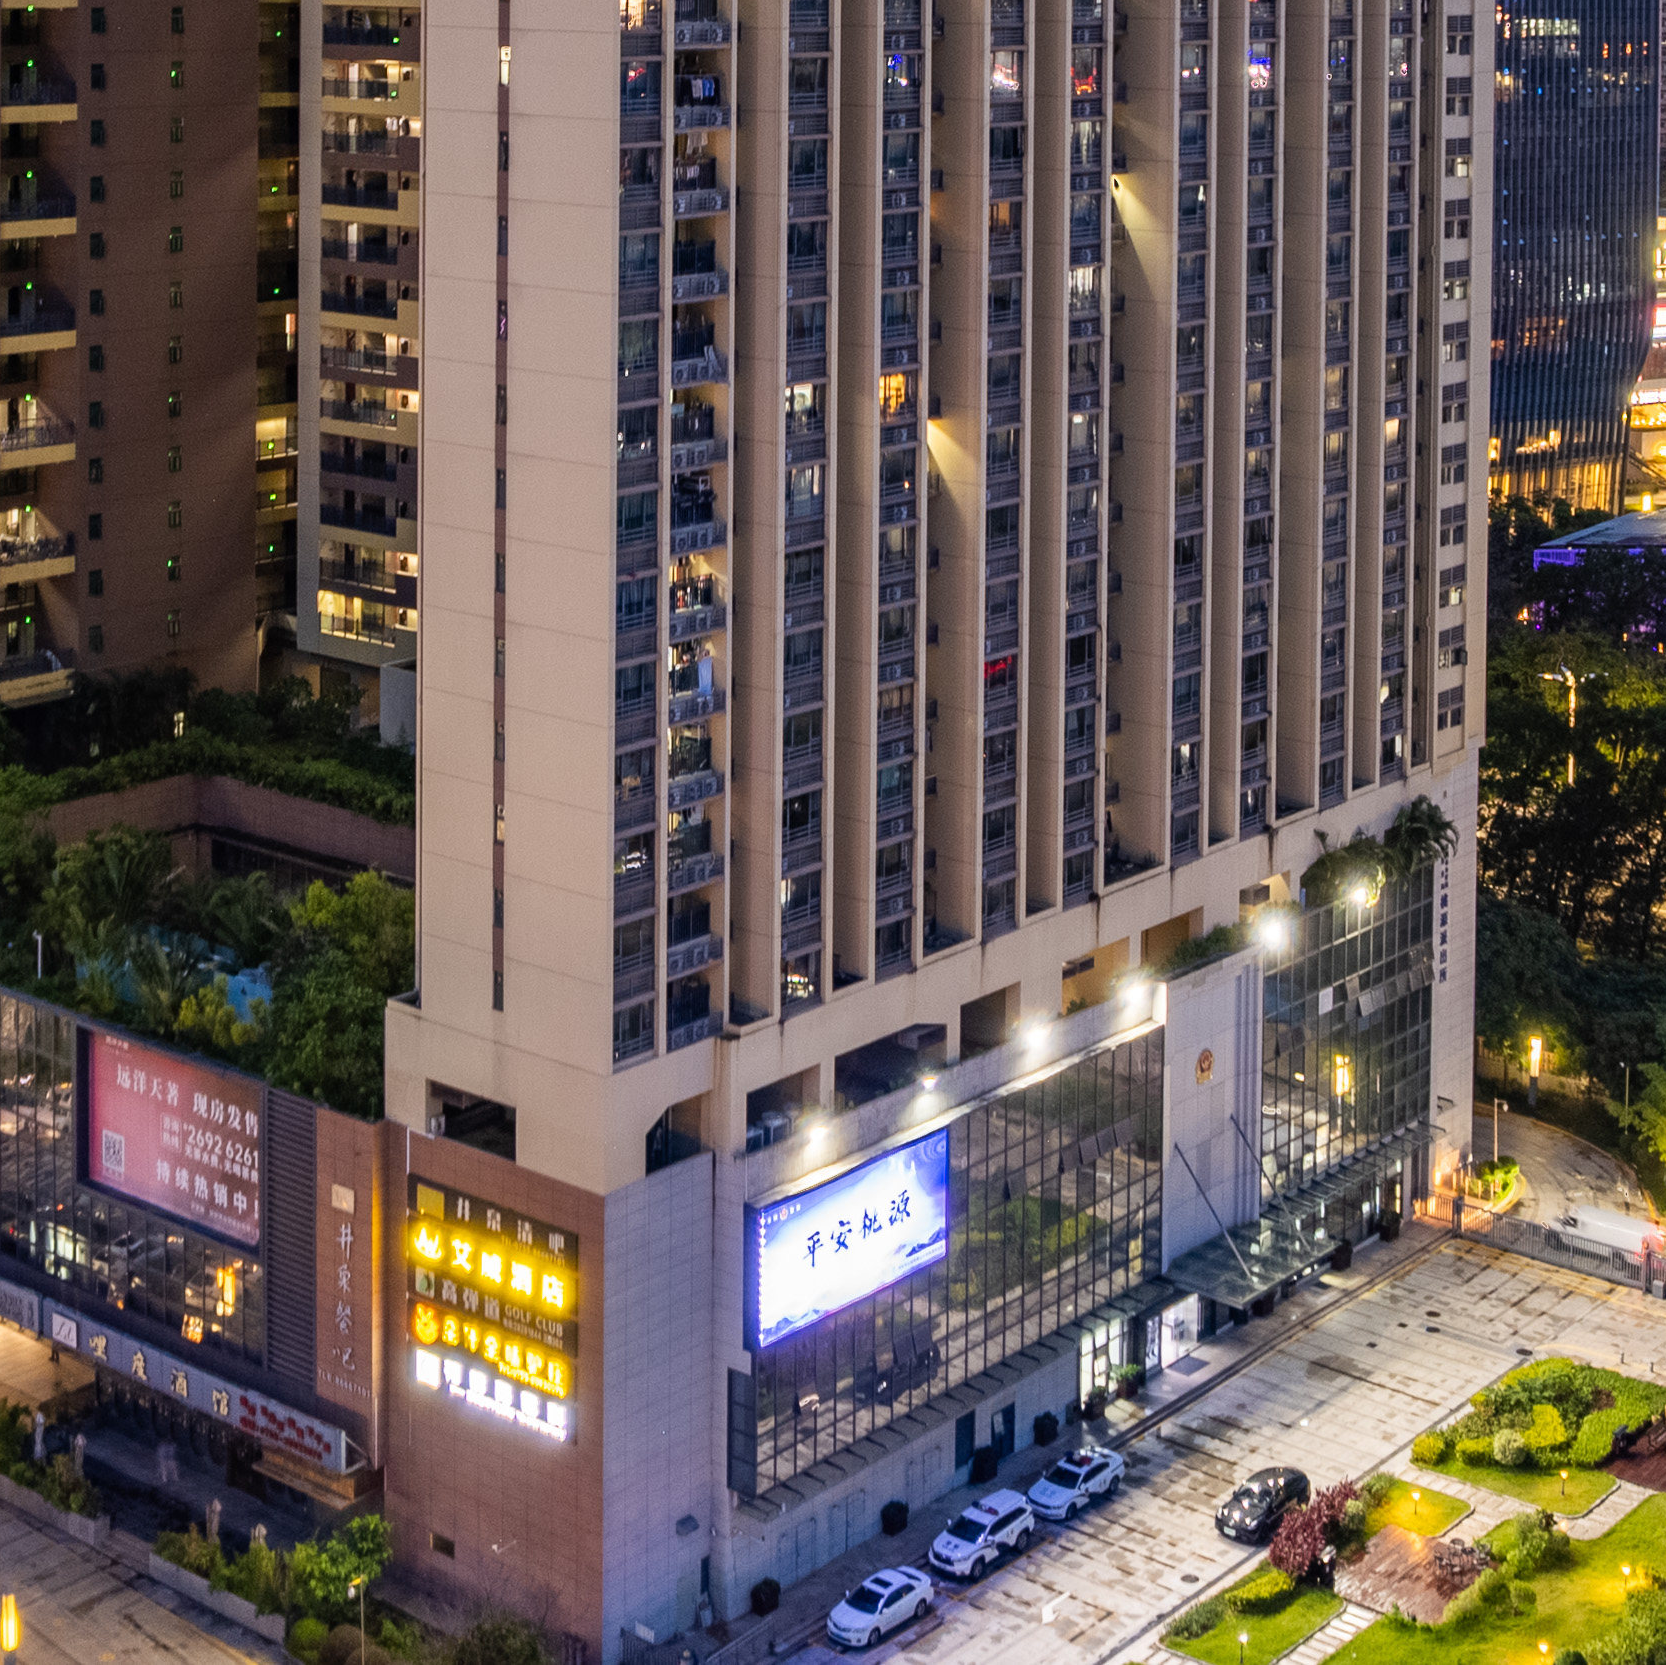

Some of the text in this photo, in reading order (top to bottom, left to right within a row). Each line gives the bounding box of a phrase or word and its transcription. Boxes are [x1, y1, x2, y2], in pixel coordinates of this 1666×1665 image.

[116, 1063, 258, 1139] 远洋天著 现房发售
[803, 1189, 911, 1268] 平安桃源
[504, 1304, 531, 1324] GOLF
[535, 1315, 563, 1337] CLUB
